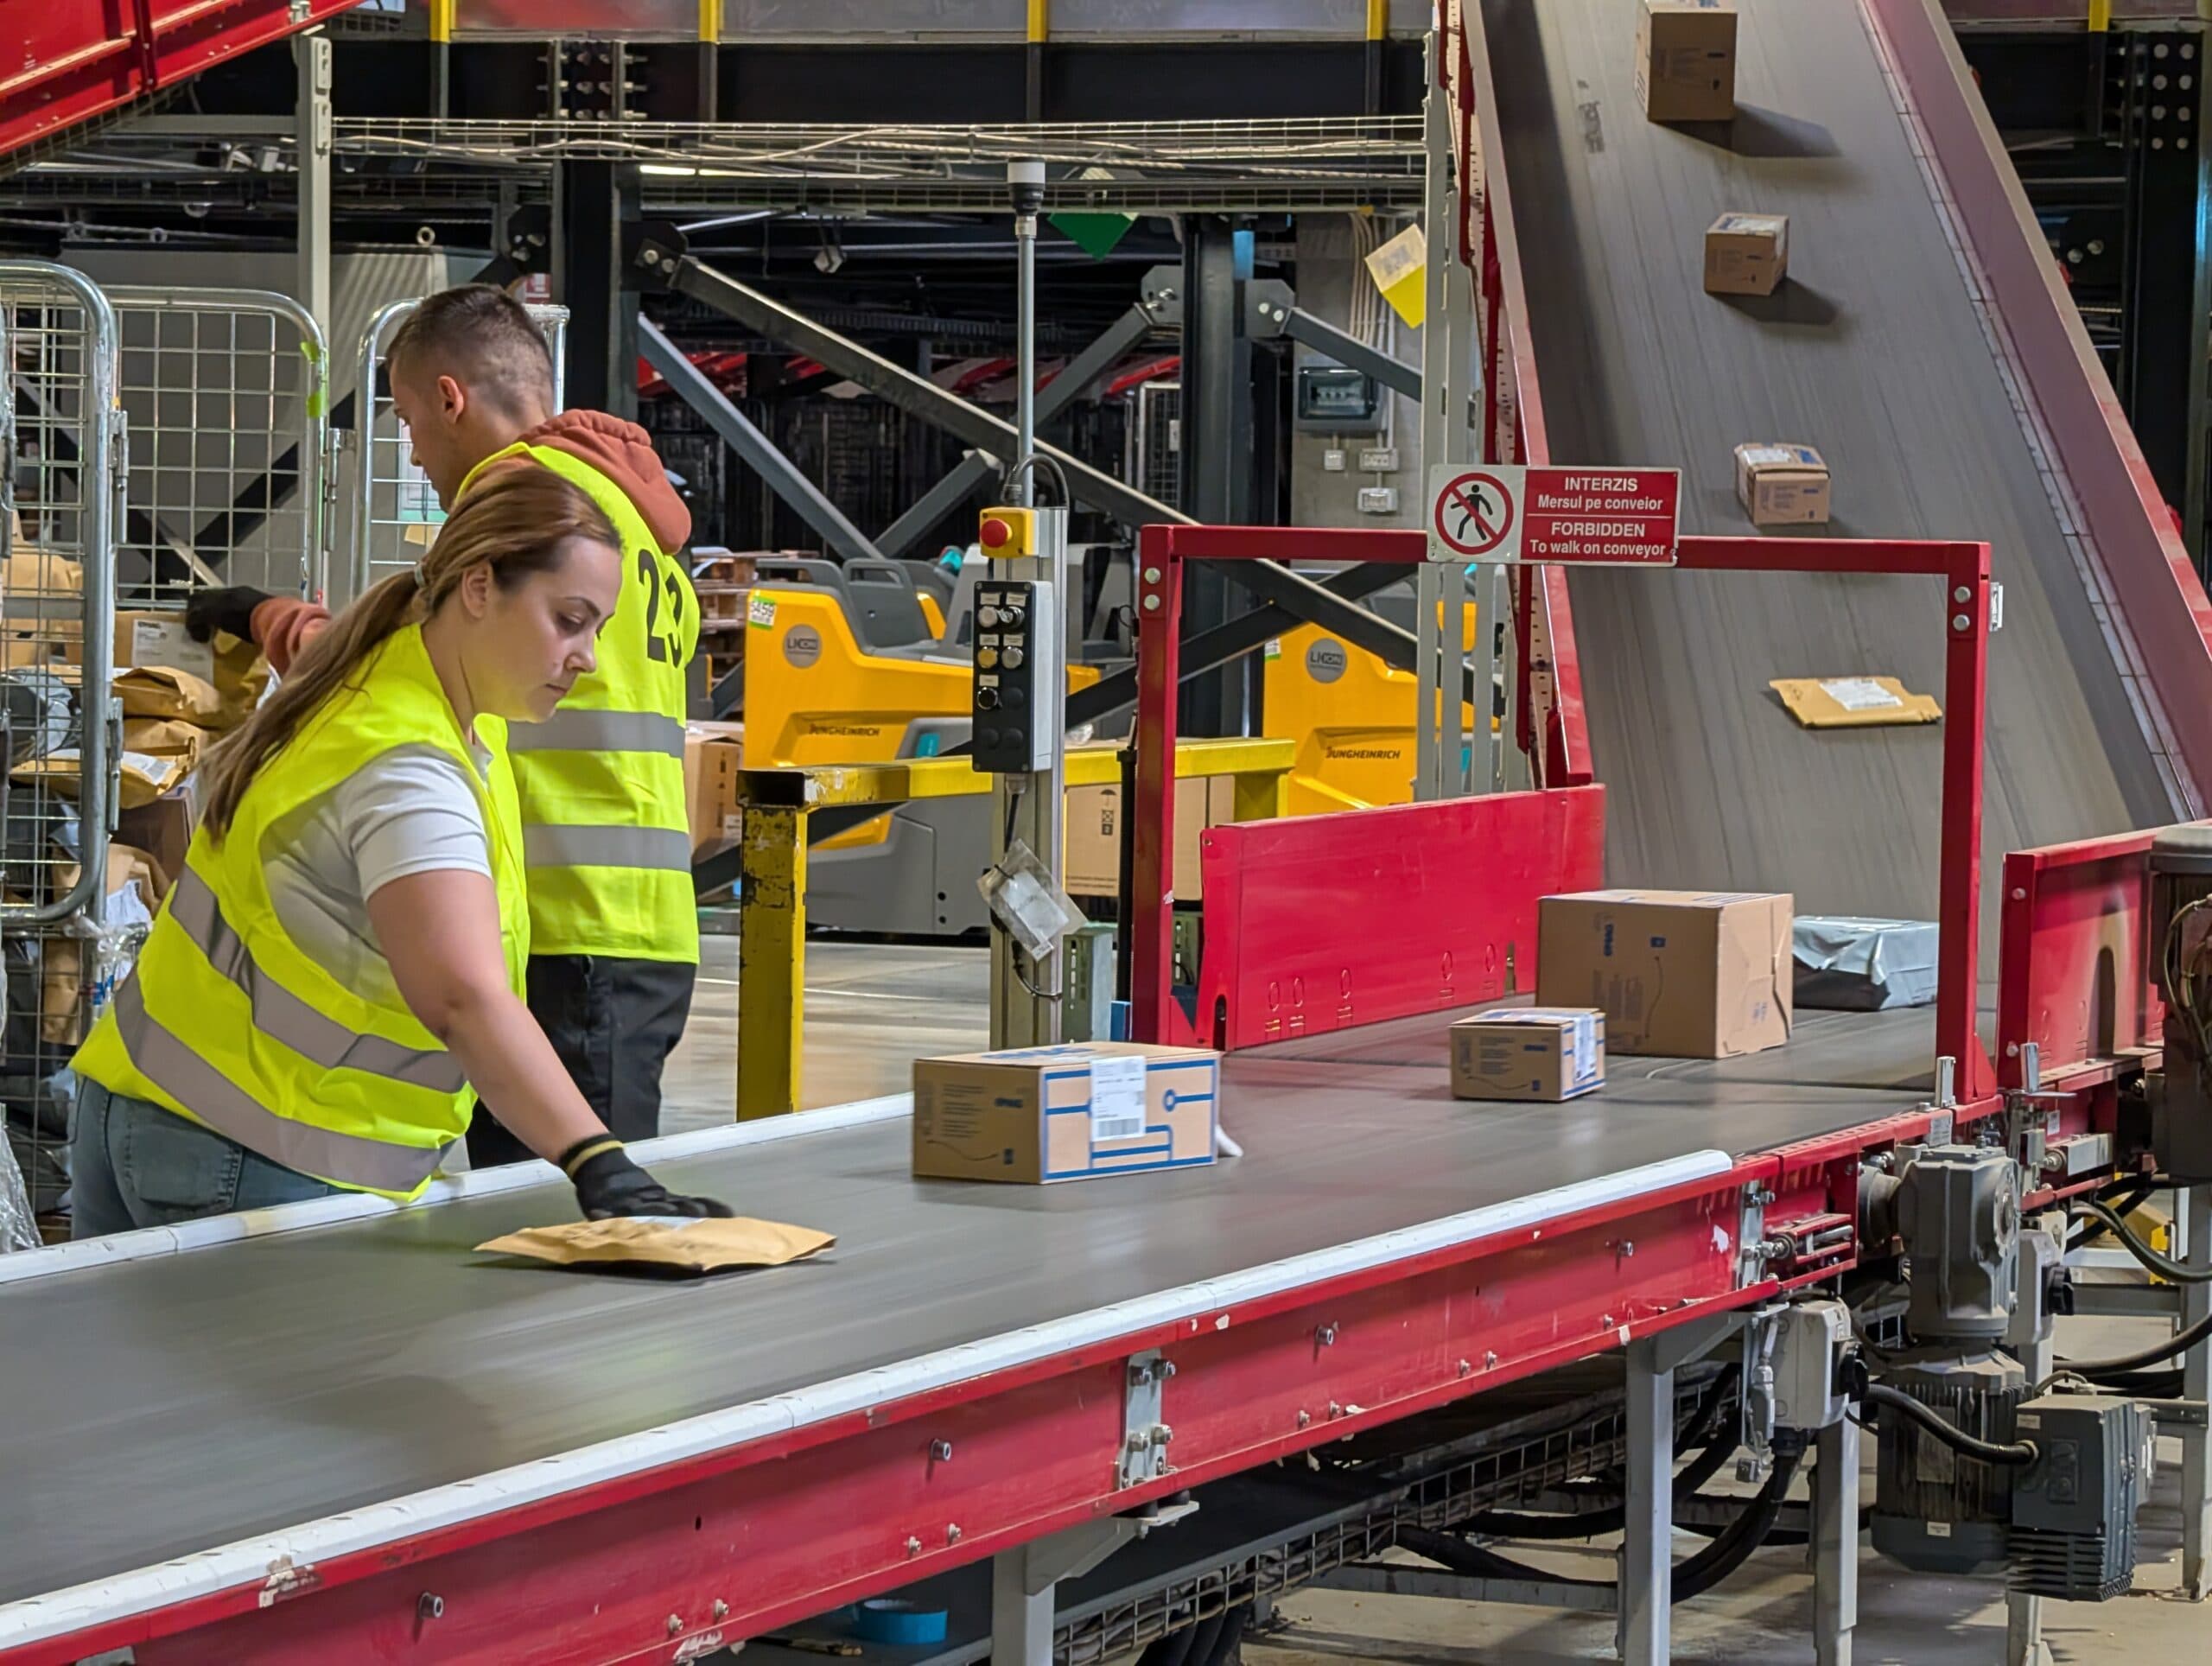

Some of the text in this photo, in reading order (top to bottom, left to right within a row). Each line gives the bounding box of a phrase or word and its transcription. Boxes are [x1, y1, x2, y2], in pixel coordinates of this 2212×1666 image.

[1565, 477, 1638, 492] INTERZIS
[1537, 494, 1663, 512] Mersul pe conveior
[1551, 522, 1645, 537] FORBIDDEN
[1530, 539, 1666, 558] To walk on conveyor
[638, 549, 683, 669] 23
[1325, 746, 1401, 760] JUNGHEINRICH
